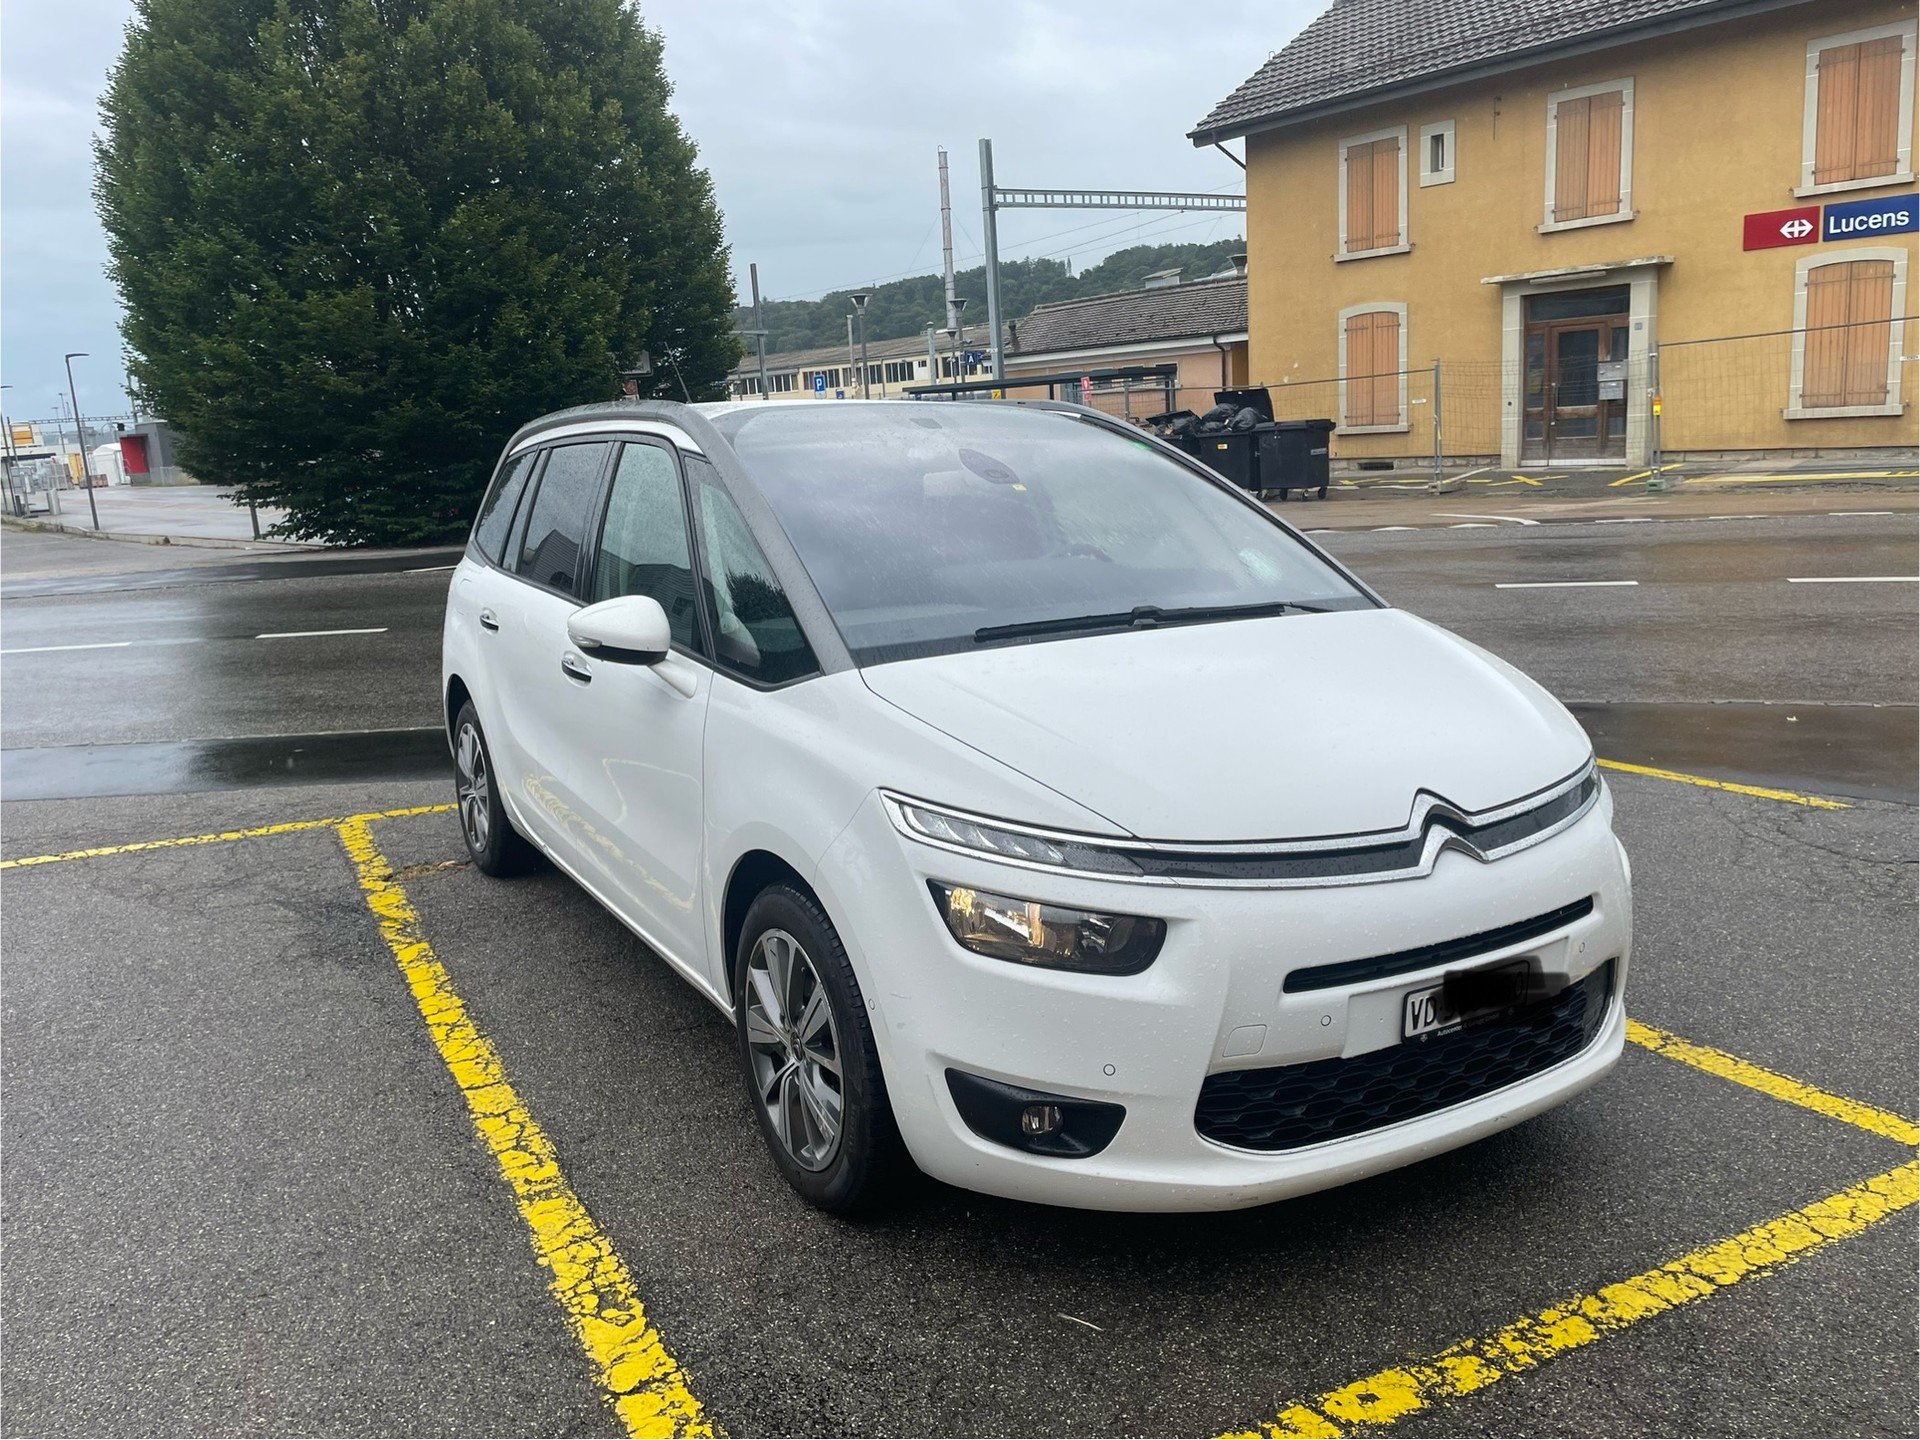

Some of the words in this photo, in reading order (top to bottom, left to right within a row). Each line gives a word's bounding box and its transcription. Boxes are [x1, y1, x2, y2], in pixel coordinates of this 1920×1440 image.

[1829, 210, 1910, 234] Lucens
[816, 378, 823, 391] P
[1411, 996, 1437, 1031] VD
